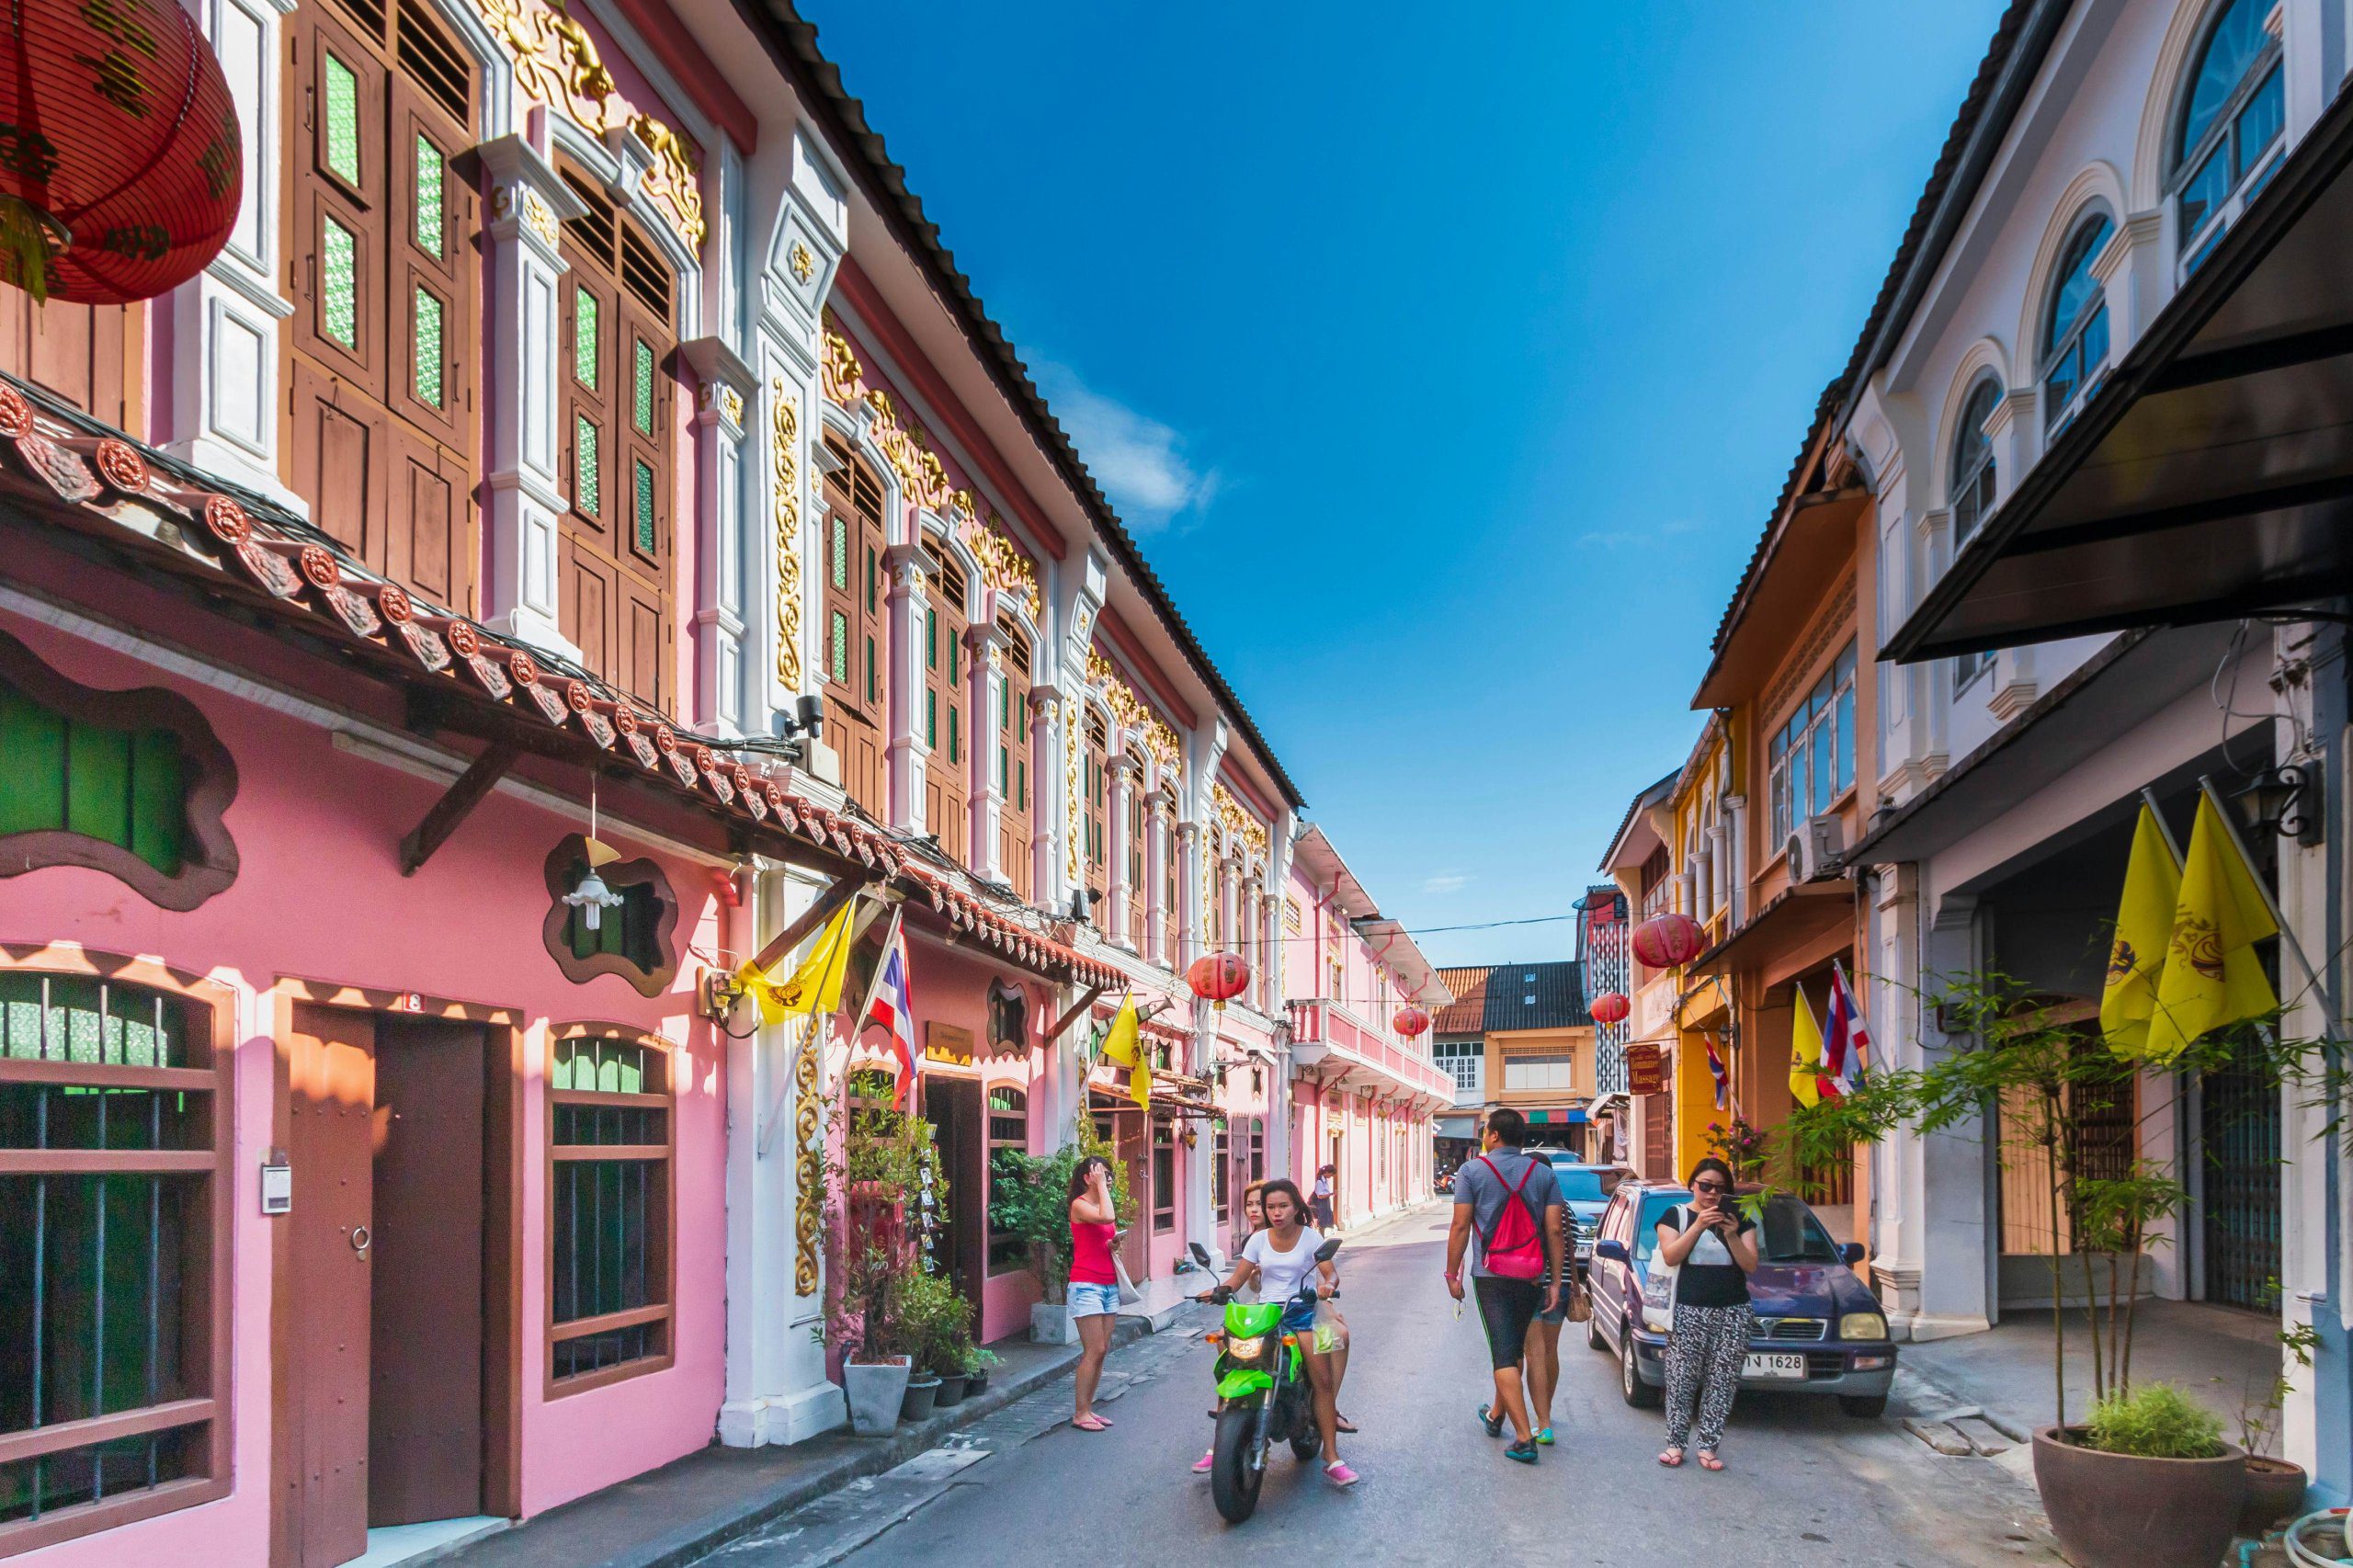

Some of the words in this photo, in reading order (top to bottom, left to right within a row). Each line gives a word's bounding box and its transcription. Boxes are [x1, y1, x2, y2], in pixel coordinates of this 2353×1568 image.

[409, 994, 421, 1010] 8
[1631, 1071, 1659, 1086] Massage
[1768, 1356, 1802, 1369] 1628
